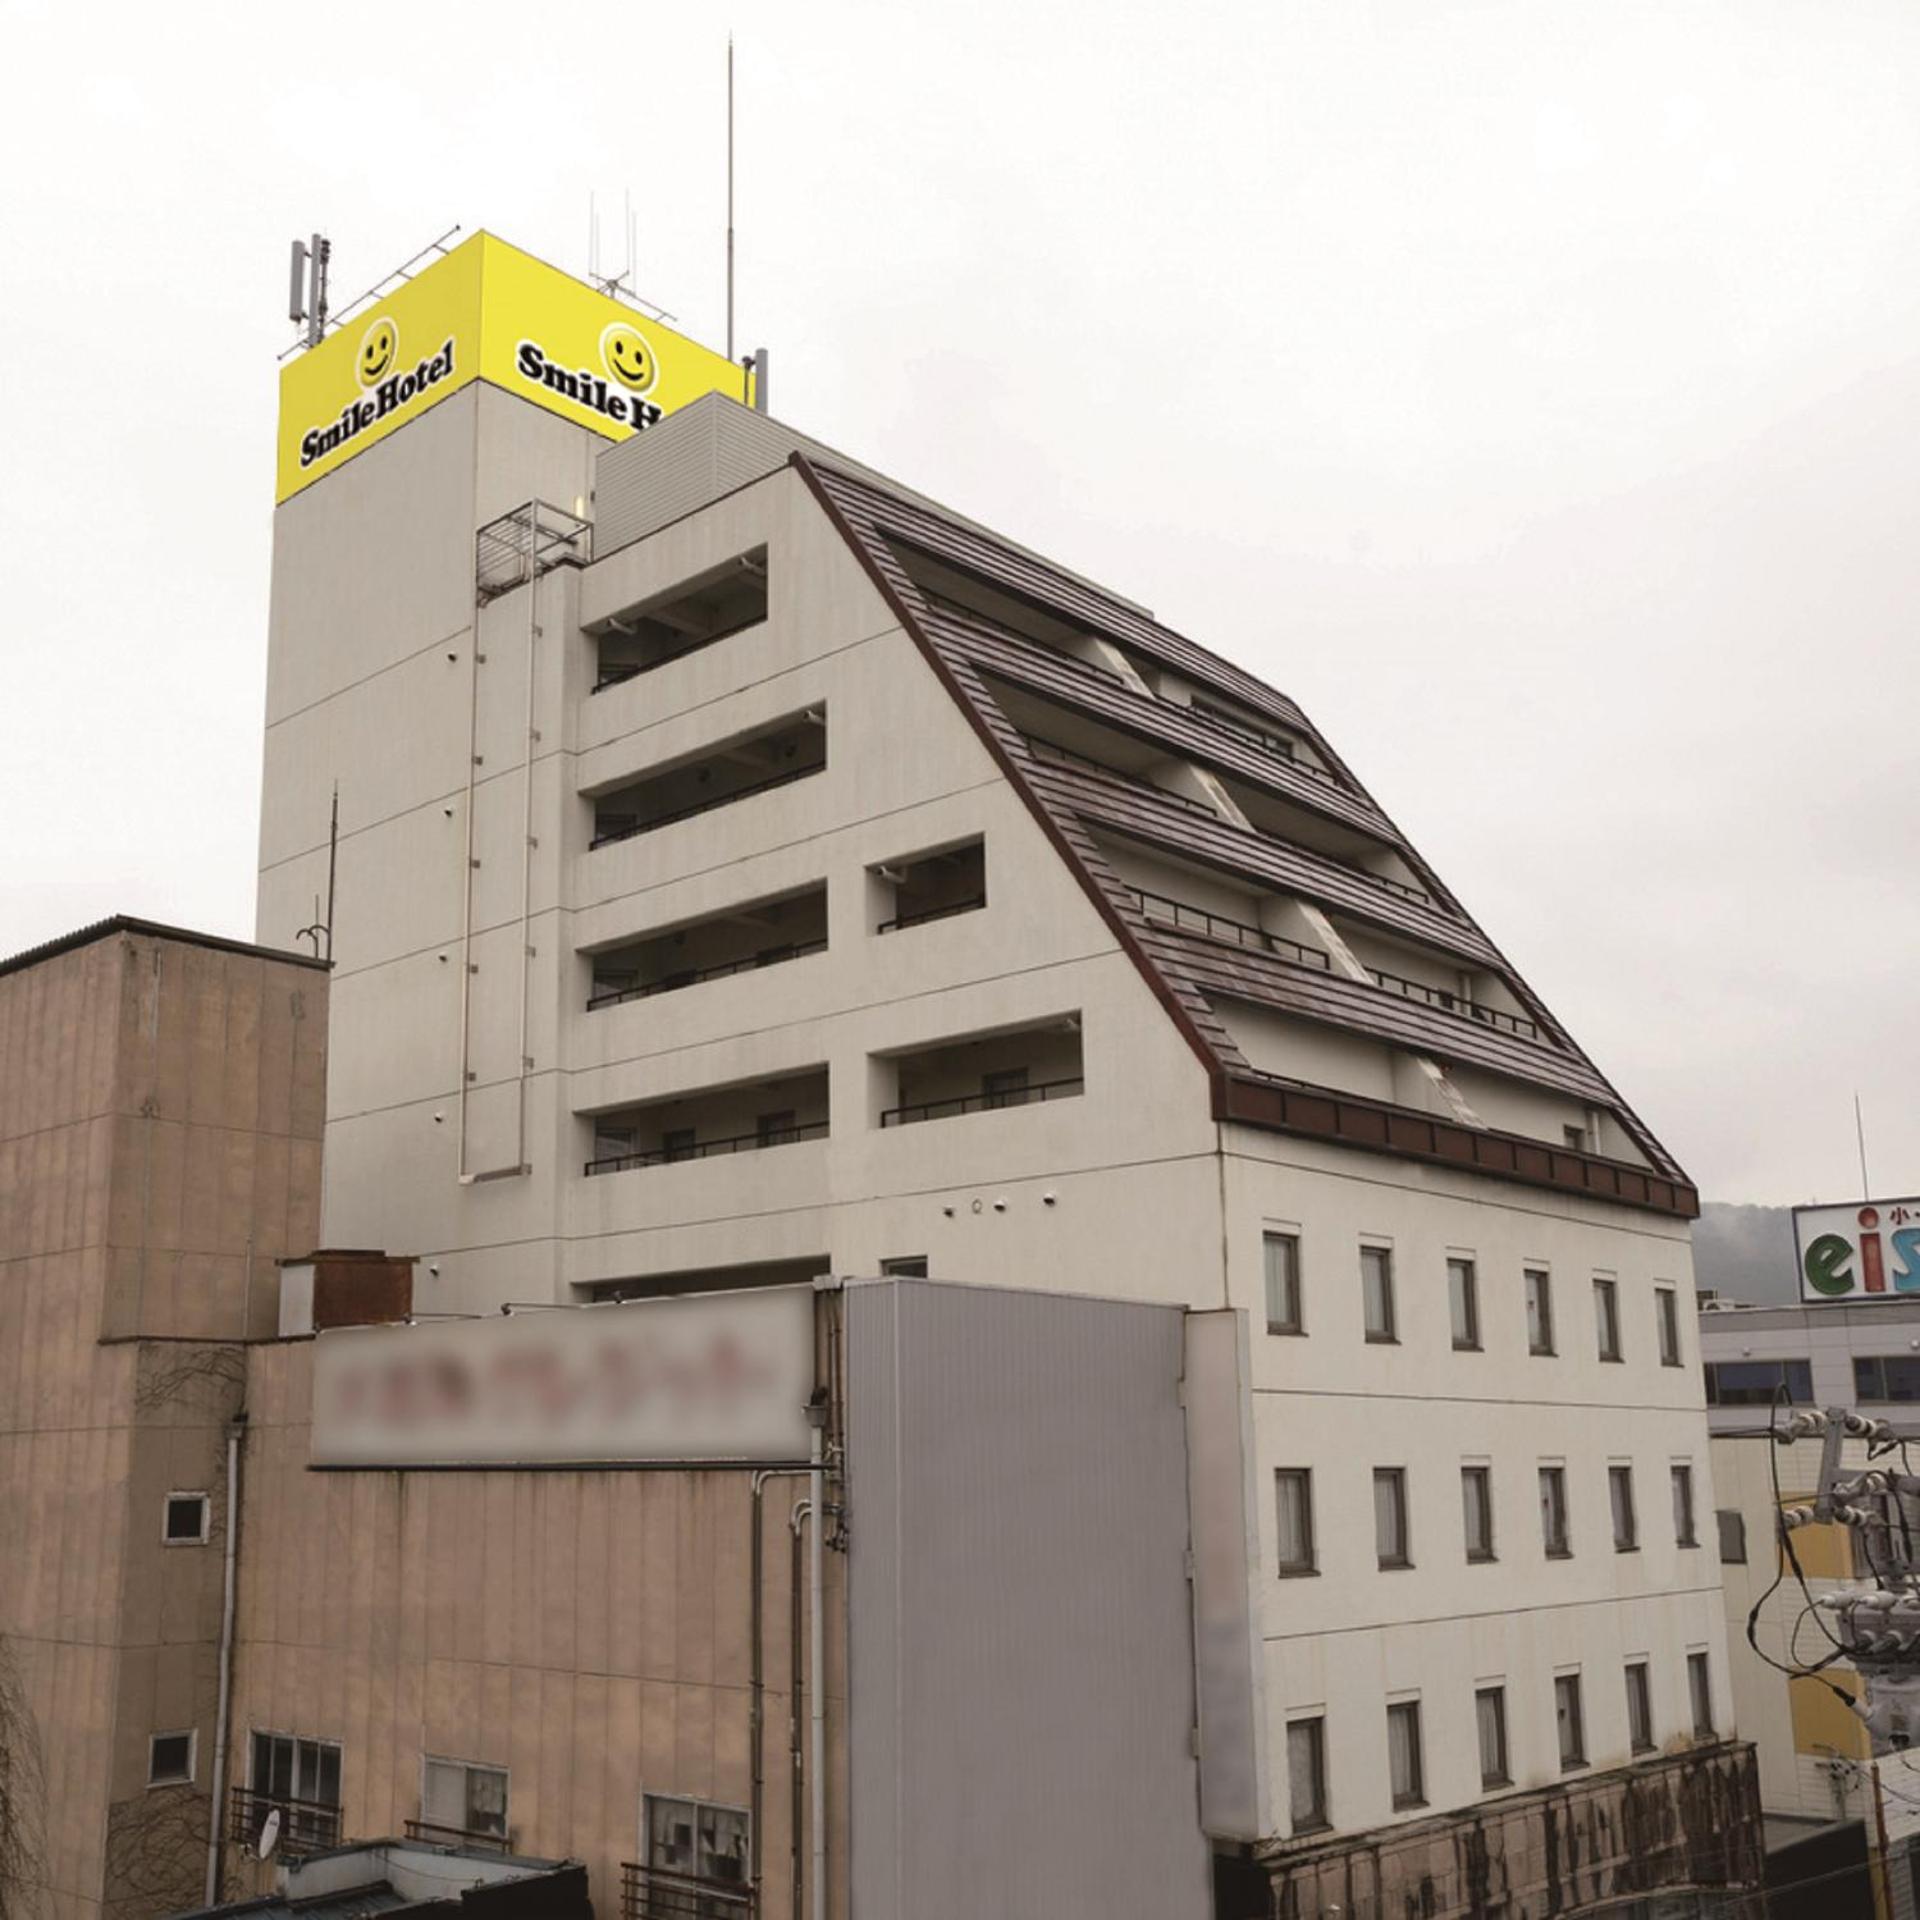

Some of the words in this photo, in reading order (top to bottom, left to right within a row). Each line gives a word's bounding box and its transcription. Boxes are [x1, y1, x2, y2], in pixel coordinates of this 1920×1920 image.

[301, 401, 375, 467] Smile
[376, 339, 453, 419] Hotel
[518, 344, 628, 421] Smile
